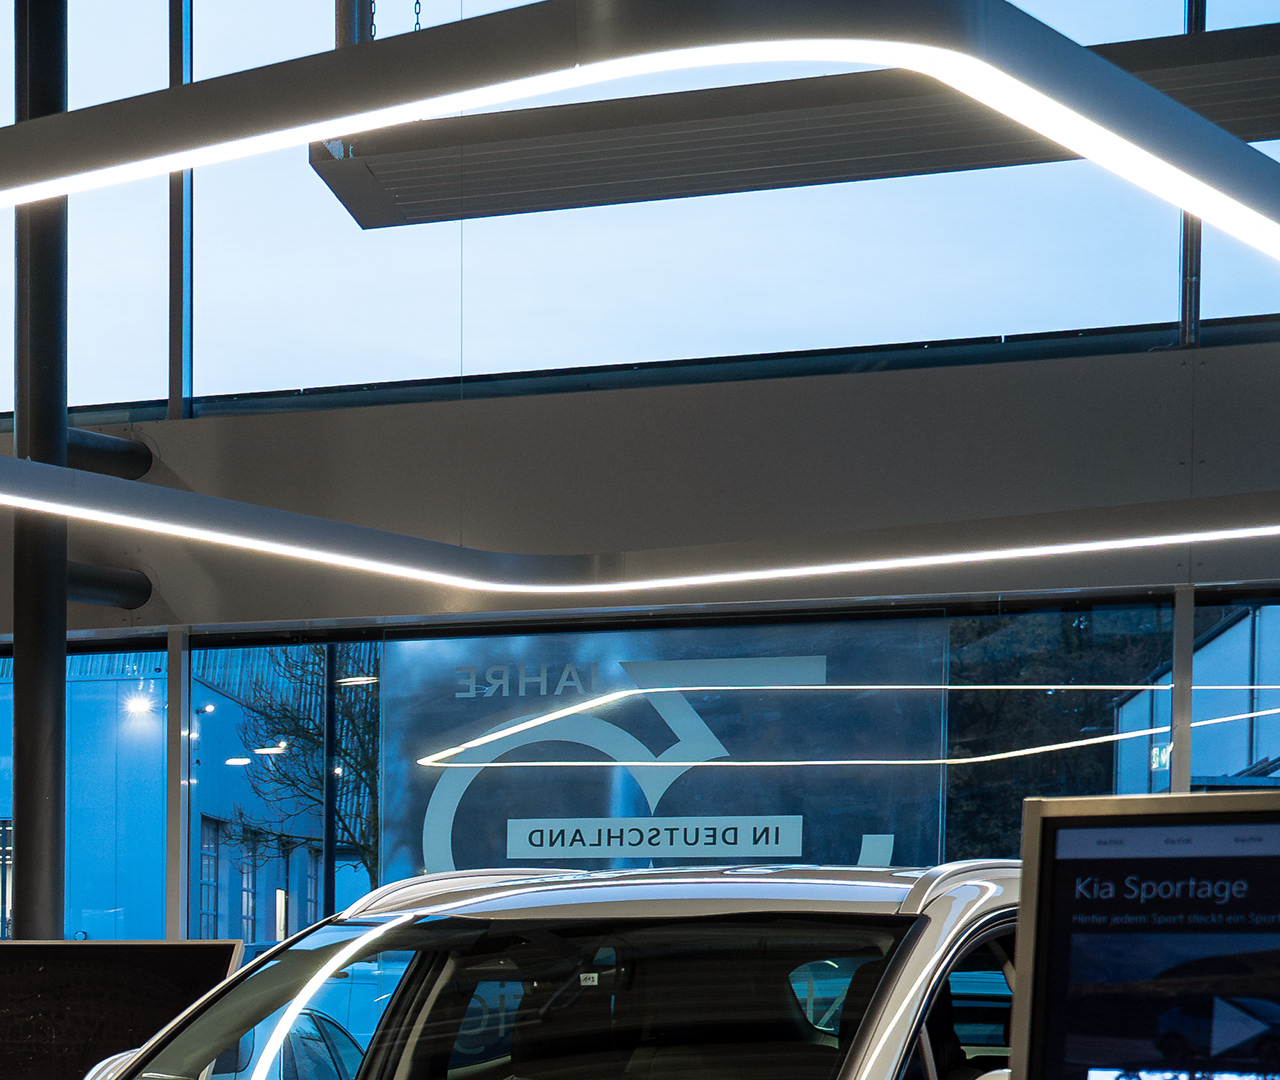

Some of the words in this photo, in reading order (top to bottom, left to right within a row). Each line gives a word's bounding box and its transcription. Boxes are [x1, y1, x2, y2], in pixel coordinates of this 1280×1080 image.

[1075, 876, 1116, 899] Kia
[1124, 875, 1249, 904] Sportage
[1072, 913, 1108, 925] Hinter
[1150, 913, 1185, 926] Sport
